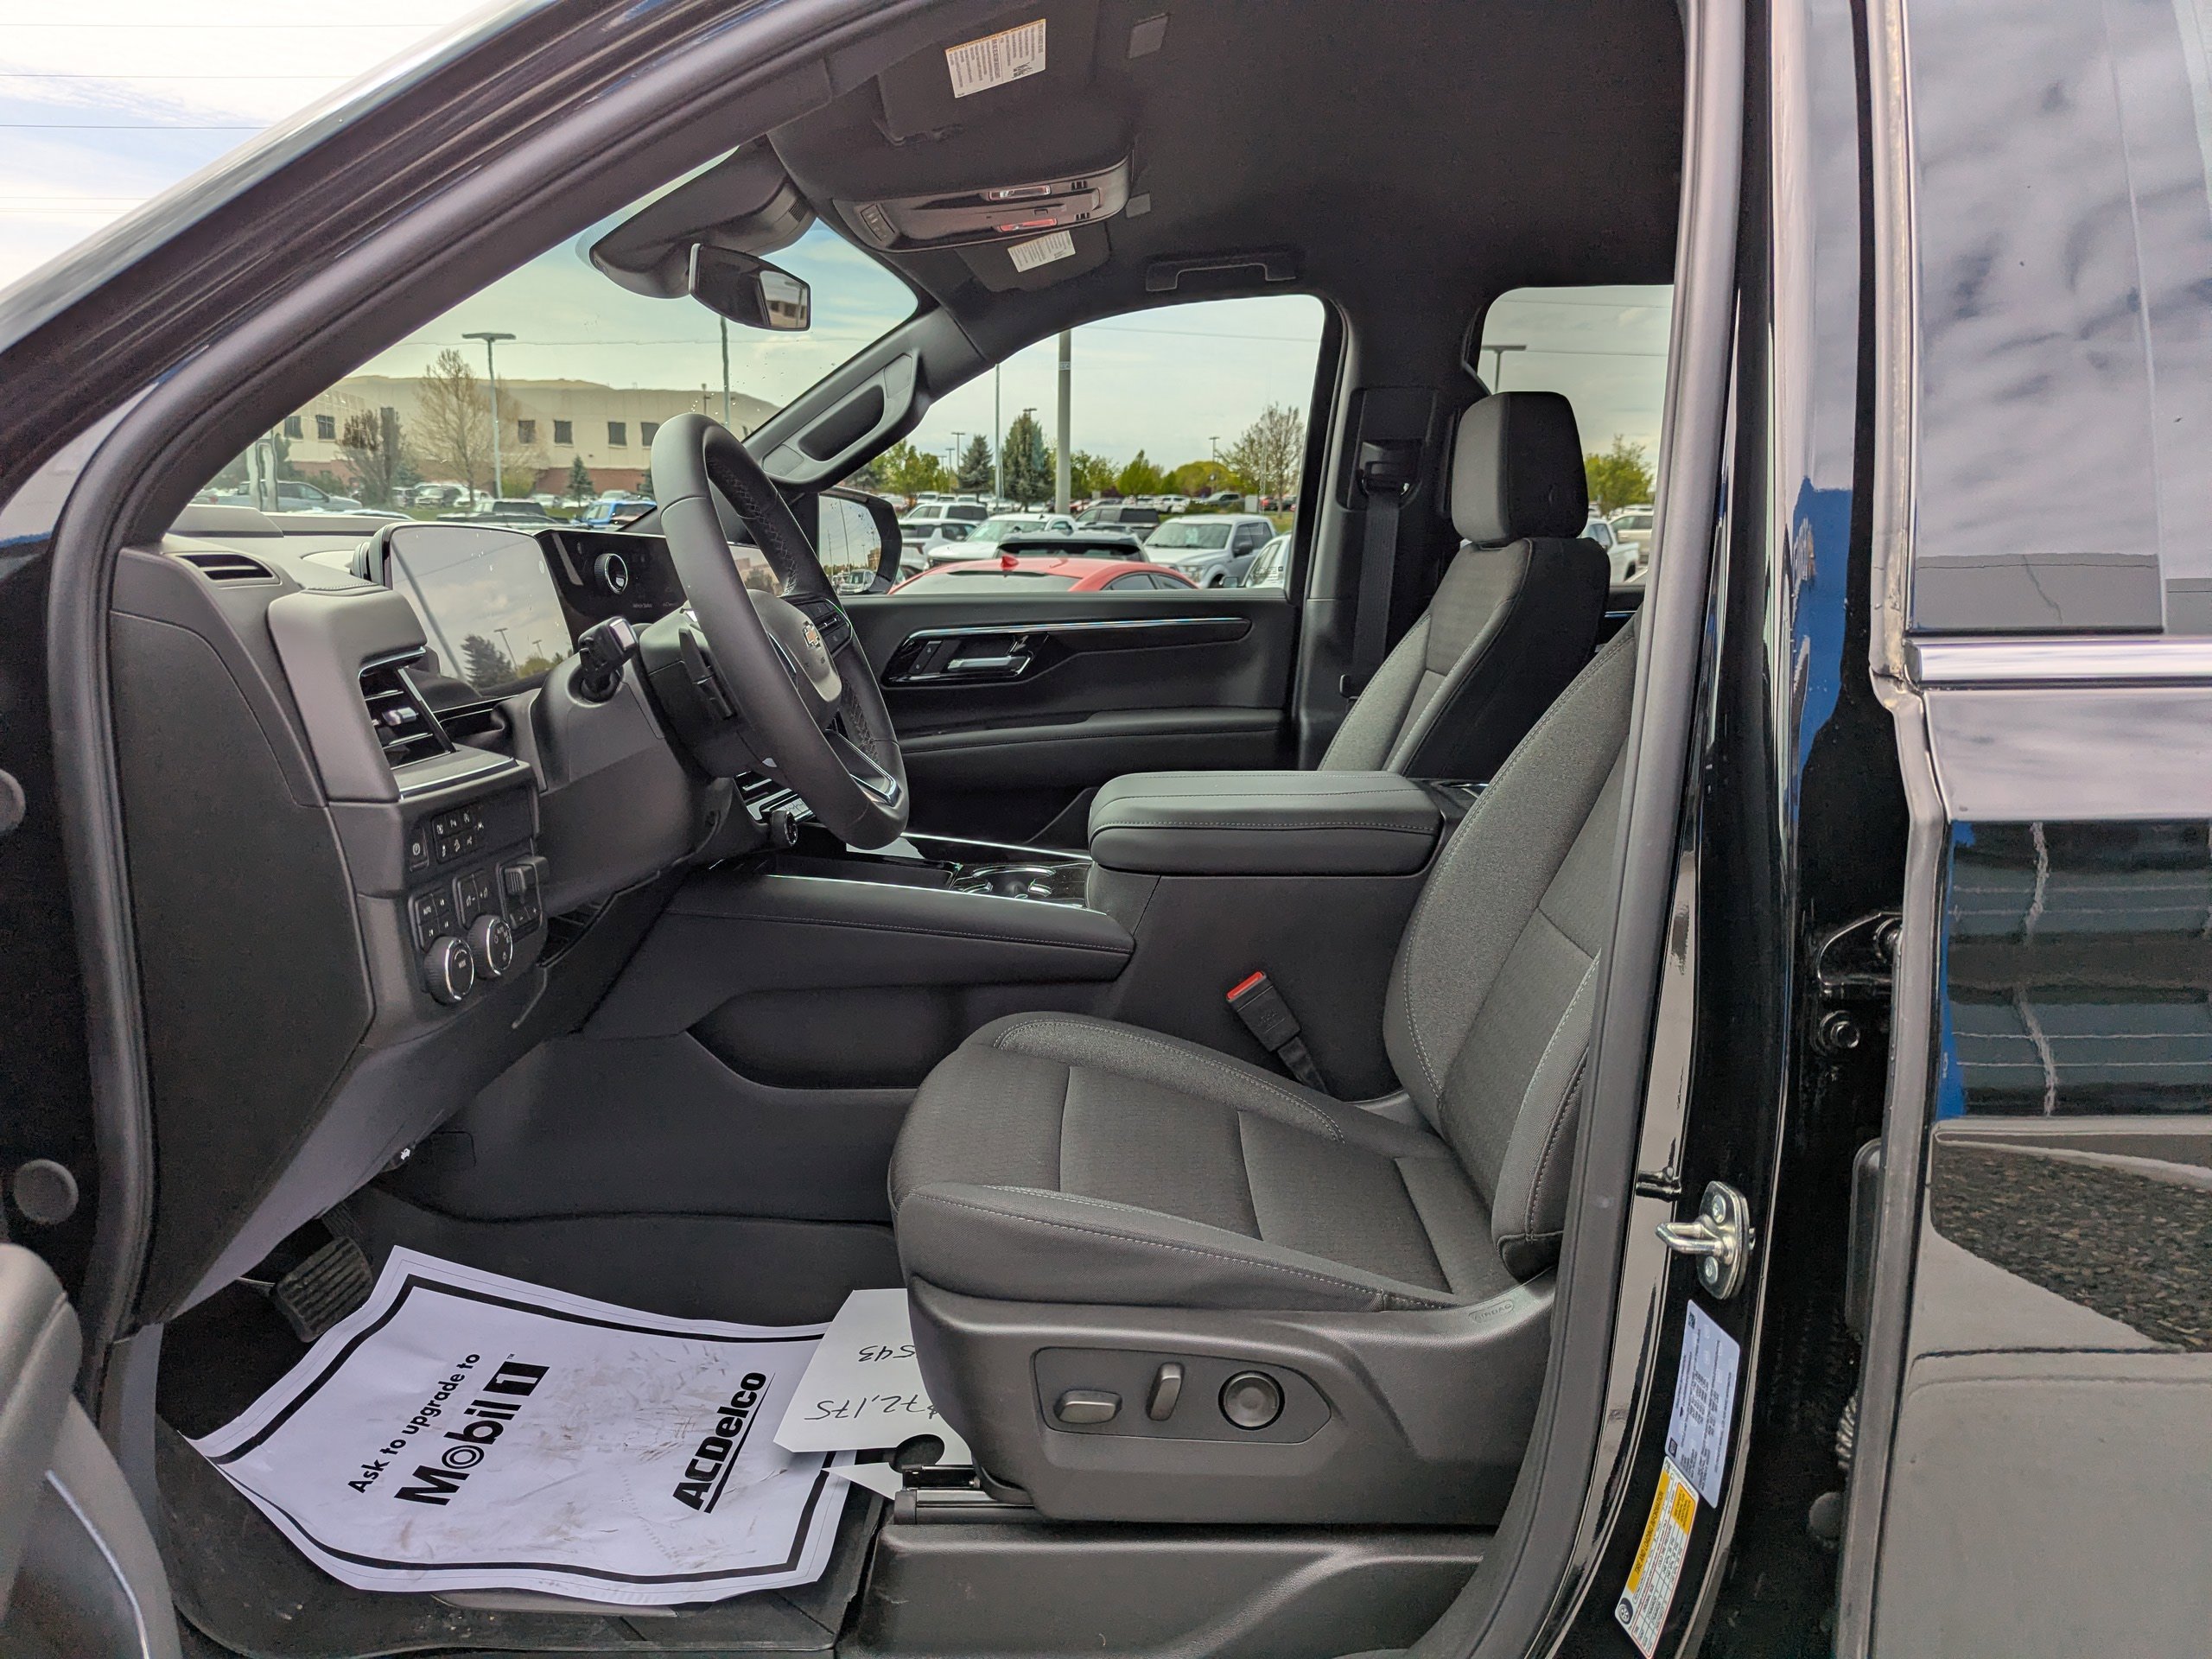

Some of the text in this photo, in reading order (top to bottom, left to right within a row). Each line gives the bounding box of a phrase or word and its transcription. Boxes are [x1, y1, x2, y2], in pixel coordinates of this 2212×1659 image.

[347, 1353, 480, 1494] Ask to upgrade to
[394, 1399, 522, 1506] Mobil
[672, 1372, 766, 1511] ACDelco
[1634, 1558, 1643, 1575] TIRE
[1642, 1523, 1653, 1551] LOADING
[1649, 1491, 1664, 1527] INFORMATION
